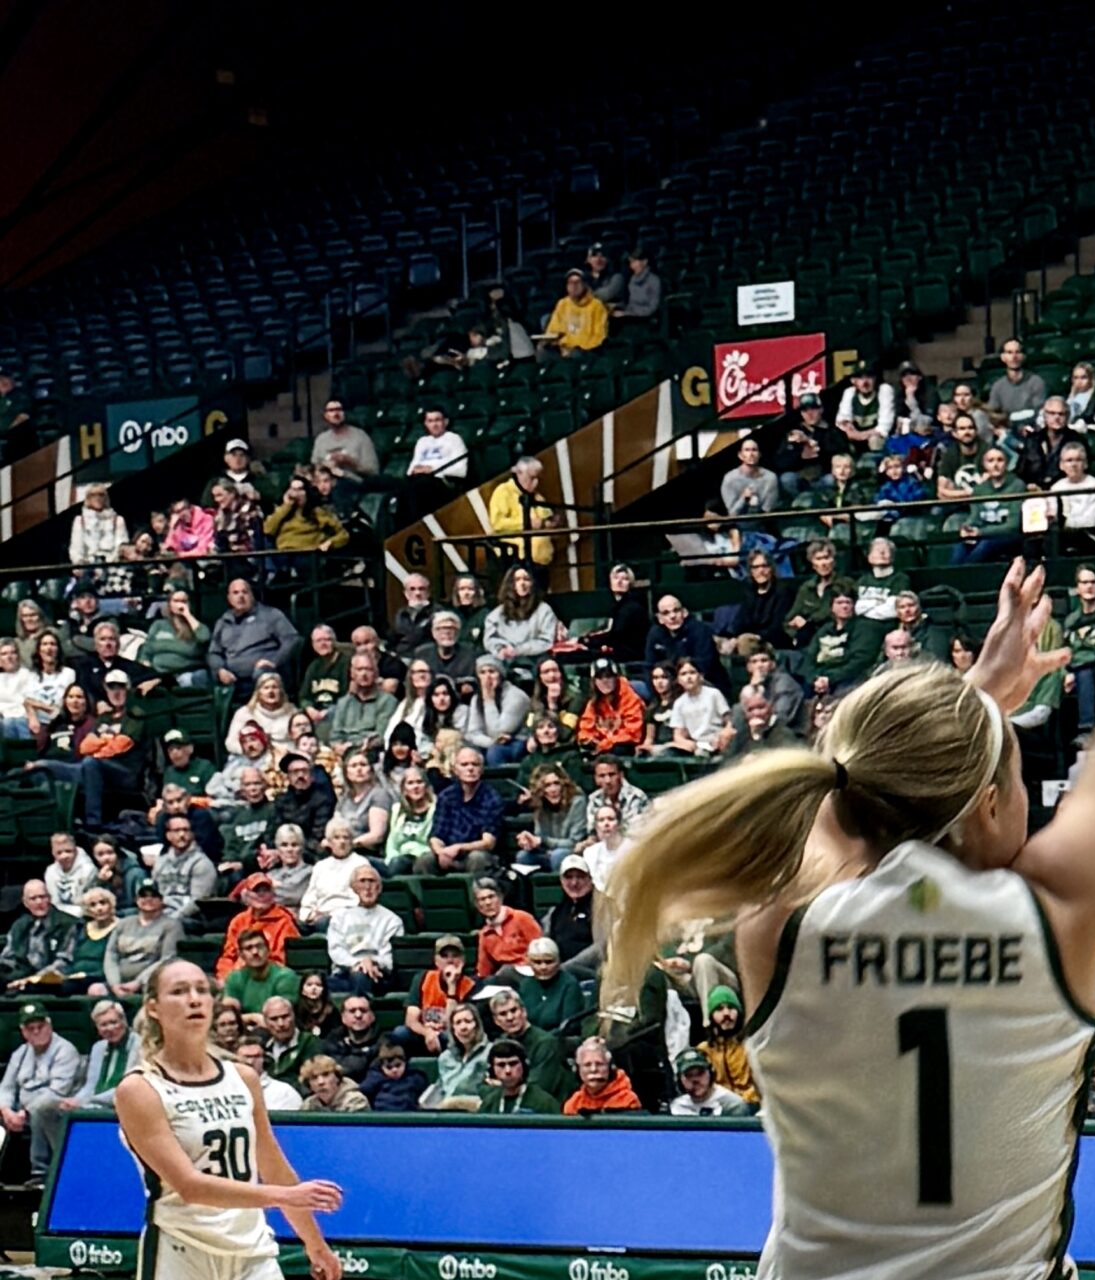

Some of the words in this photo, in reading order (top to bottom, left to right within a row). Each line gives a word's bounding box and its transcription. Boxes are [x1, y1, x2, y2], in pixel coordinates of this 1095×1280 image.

[681, 366, 710, 407] G
[79, 422, 103, 460] H
[404, 535, 426, 567] G
[821, 933, 1024, 986] FROEBE
[897, 1005, 954, 1207] 1
[201, 1126, 252, 1182] 30
[458, 1258, 497, 1279] fnbo
